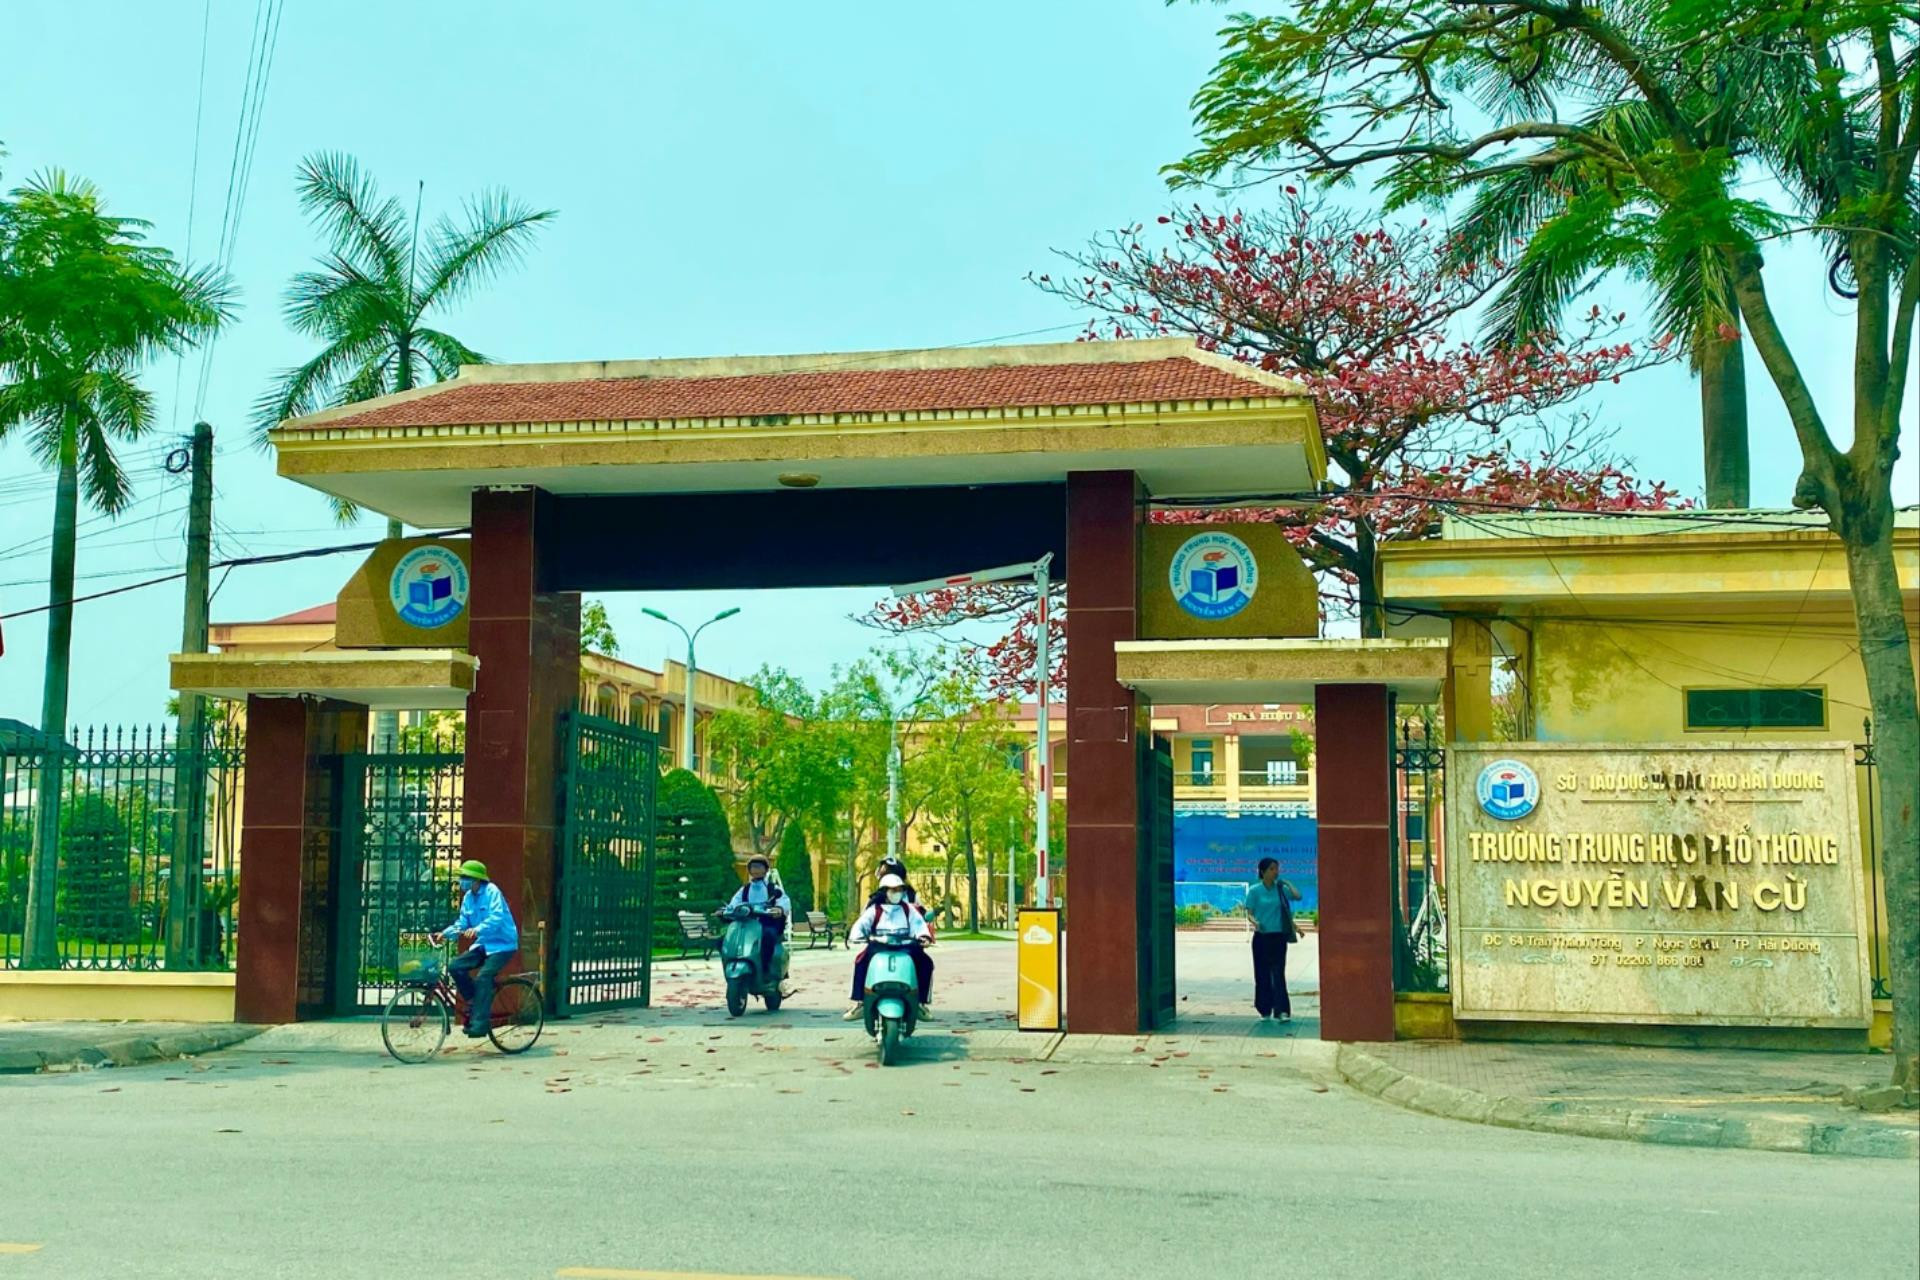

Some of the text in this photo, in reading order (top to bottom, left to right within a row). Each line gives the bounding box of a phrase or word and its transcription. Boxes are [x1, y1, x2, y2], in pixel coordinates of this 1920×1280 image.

[1618, 772, 1649, 793] DỤC
[1709, 772, 1738, 793] TẠO
[1469, 824, 1839, 868] TRƯỜNG TRUNG HỌC PHỔ THÔNG
[1506, 869, 1808, 912] NGUYỄN VĂN CỪ
